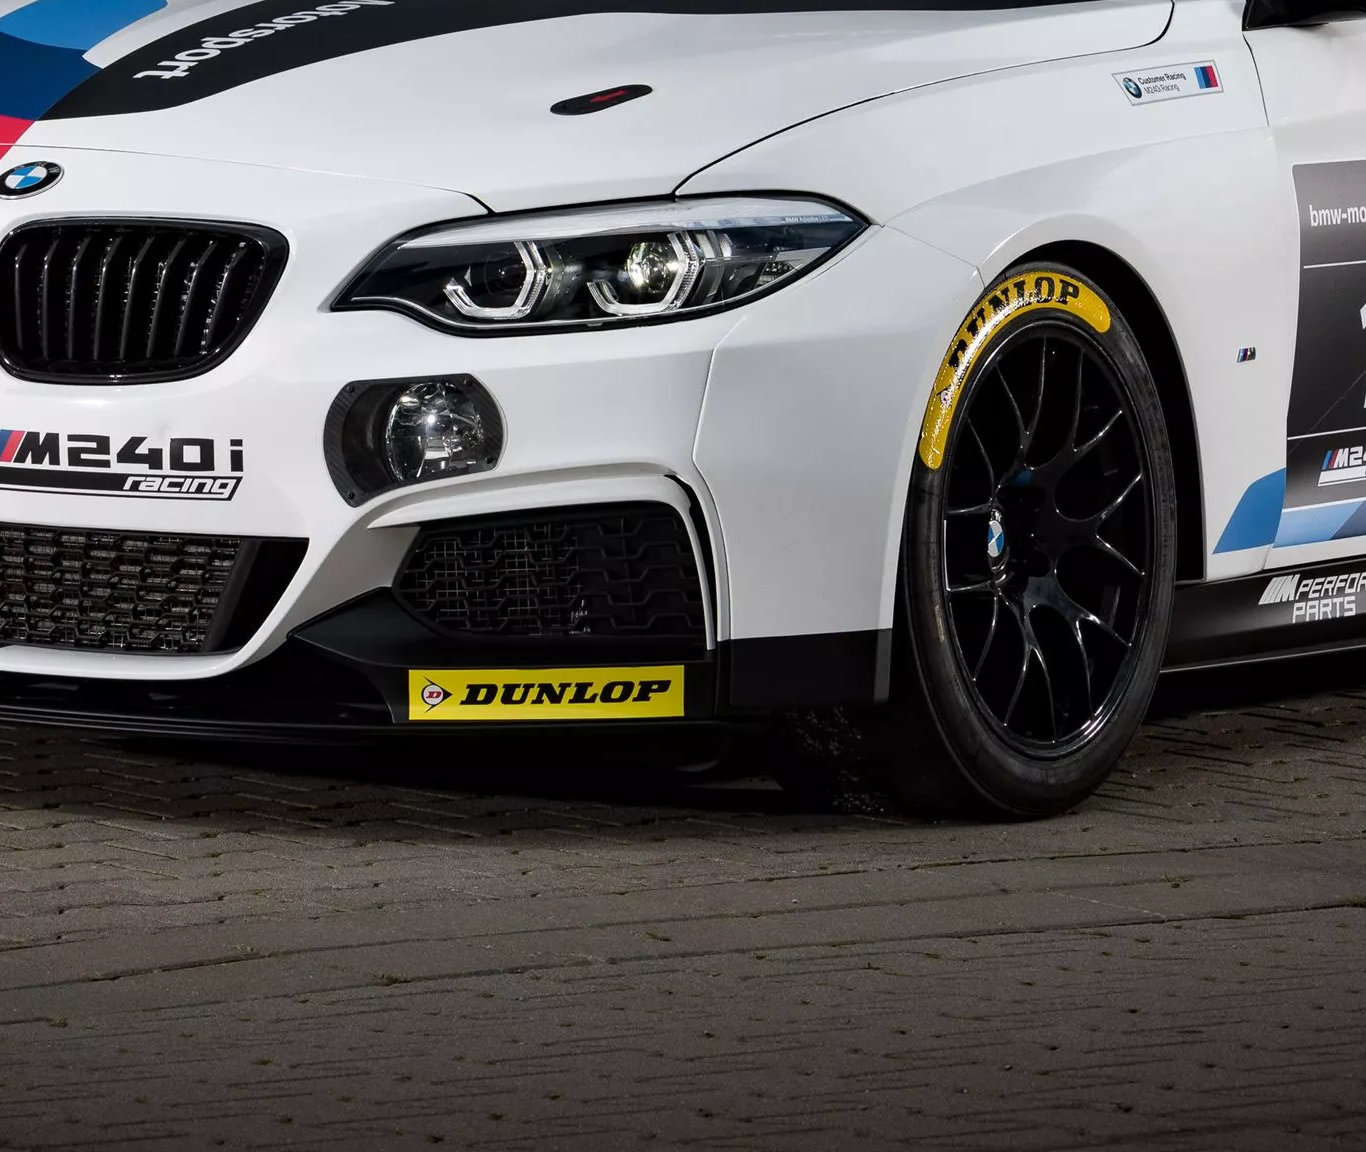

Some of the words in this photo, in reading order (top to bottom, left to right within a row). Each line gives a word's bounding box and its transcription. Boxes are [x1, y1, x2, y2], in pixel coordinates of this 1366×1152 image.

[122, 475, 237, 496] racing
[1292, 596, 1356, 624] PARTS
[459, 679, 672, 706] DUNLOP
